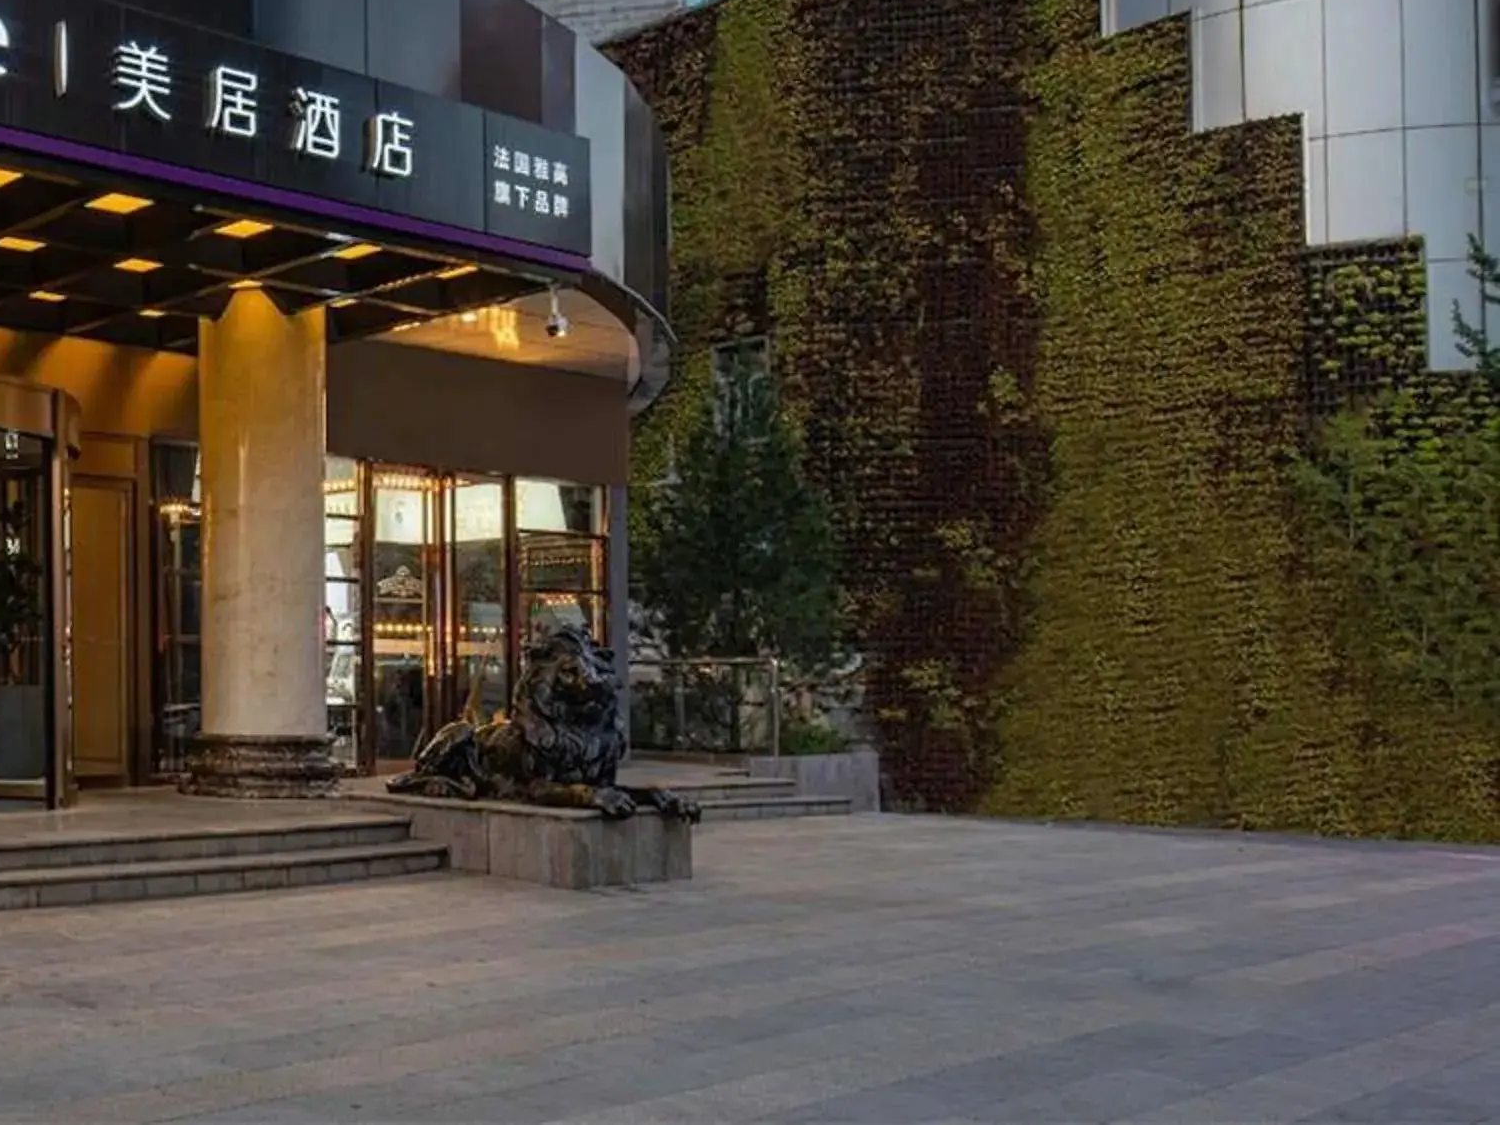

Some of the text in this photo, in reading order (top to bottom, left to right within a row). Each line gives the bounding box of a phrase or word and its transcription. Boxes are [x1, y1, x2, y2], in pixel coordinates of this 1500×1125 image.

[113, 40, 415, 176] 美居酒店
[492, 143, 570, 187] 法国雅高
[492, 179, 570, 220] 旗下品牌
